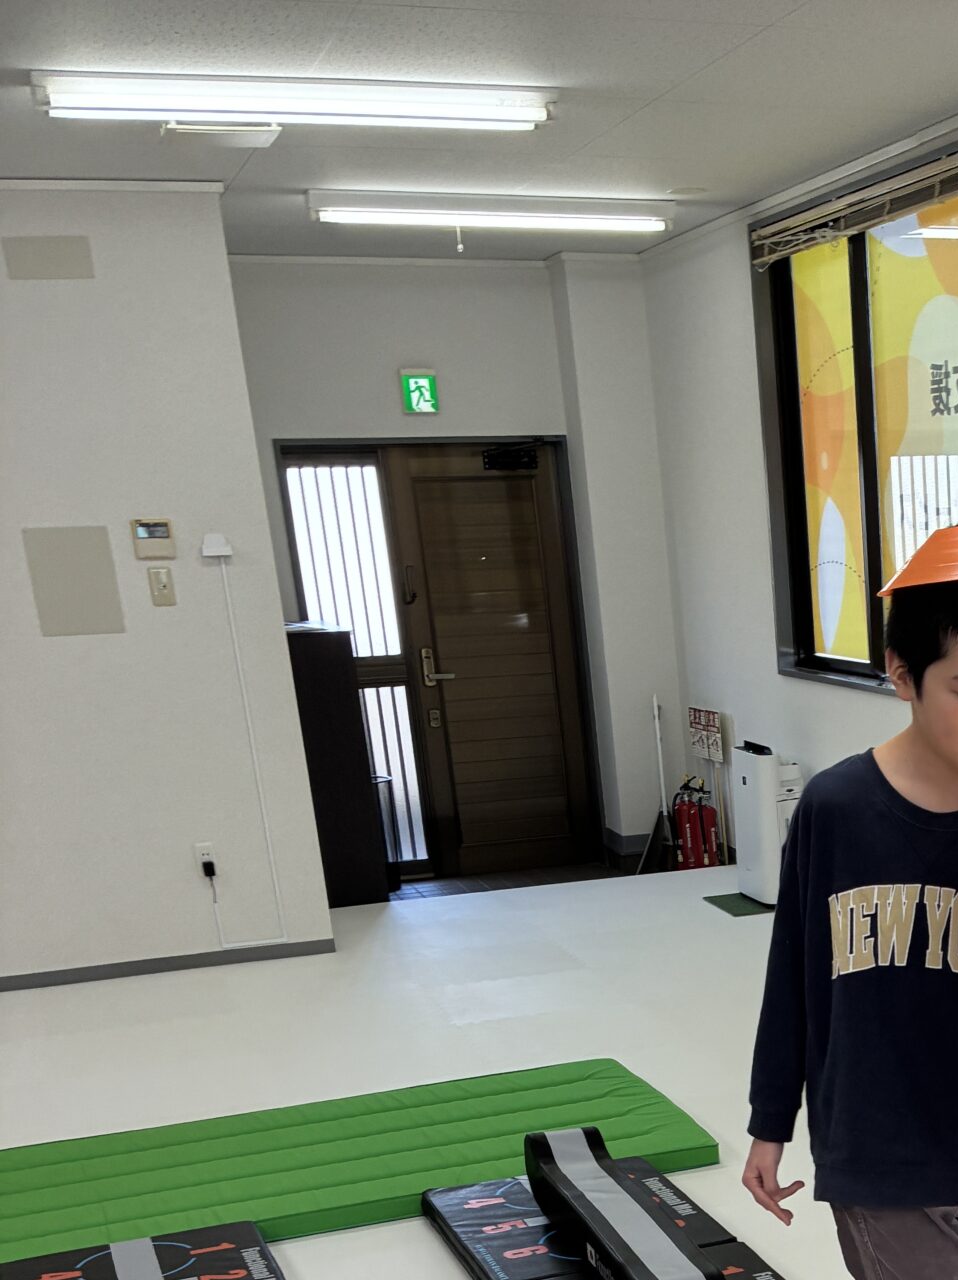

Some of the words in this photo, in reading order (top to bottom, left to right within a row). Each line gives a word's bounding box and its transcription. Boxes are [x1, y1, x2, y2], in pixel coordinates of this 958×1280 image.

[828, 884, 922, 979] NEW
[463, 1196, 507, 1209] 4
[641, 1177, 687, 1206] Functional
[671, 1203, 698, 1216] Mat
[481, 1219, 528, 1234] 5
[190, 1242, 236, 1255] 1
[502, 1245, 549, 1259] 6
[240, 1246, 275, 1280] Functional
